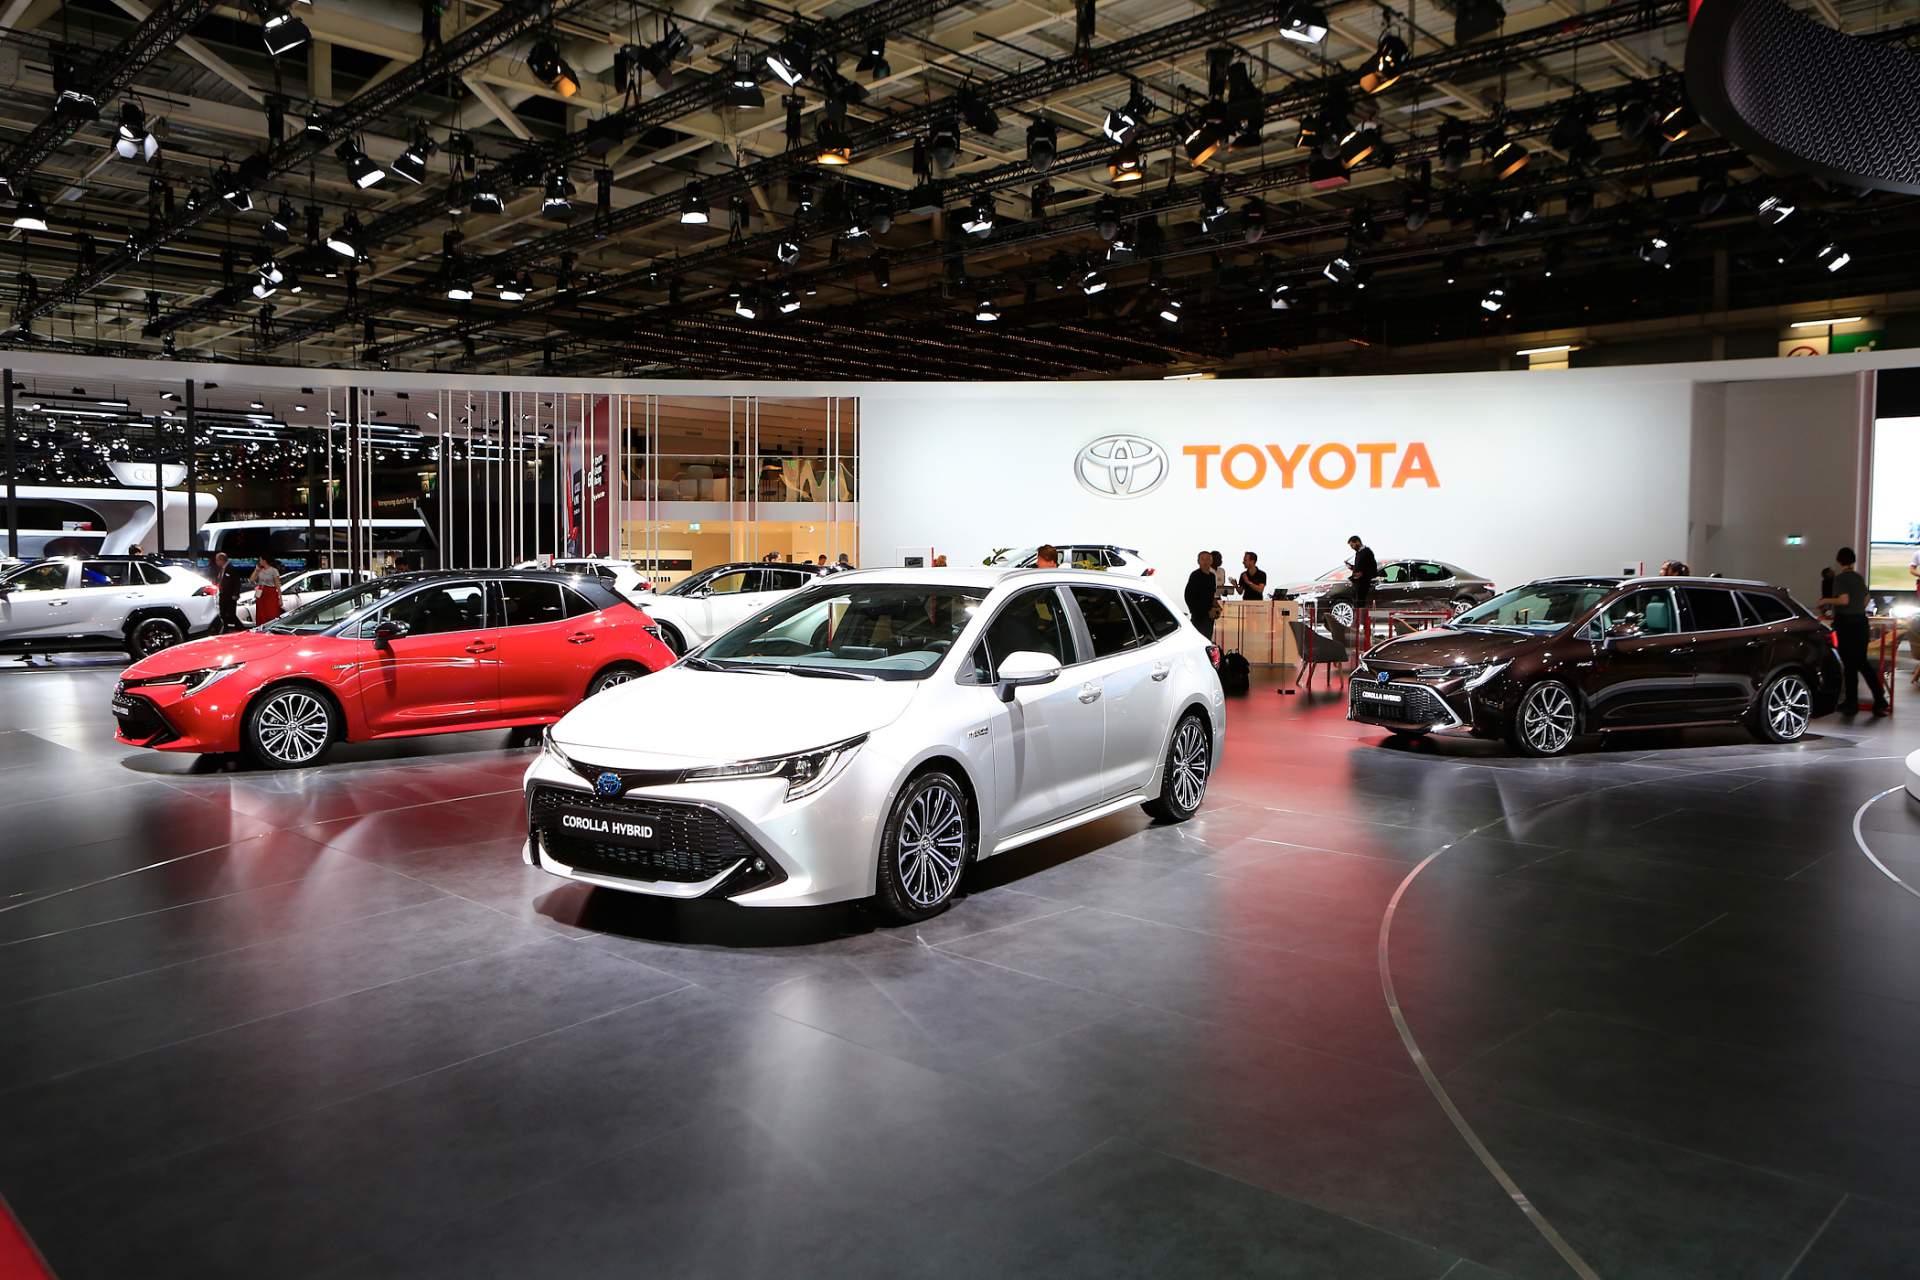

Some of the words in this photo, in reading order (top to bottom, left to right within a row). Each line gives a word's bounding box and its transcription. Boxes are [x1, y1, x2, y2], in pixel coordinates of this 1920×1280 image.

[1182, 442, 1441, 490] TOYOTA
[1362, 691, 1383, 700] COROLLA
[1383, 694, 1402, 702] HYBRID
[562, 815, 609, 832] COROLLA
[612, 822, 653, 838] HYBRID
